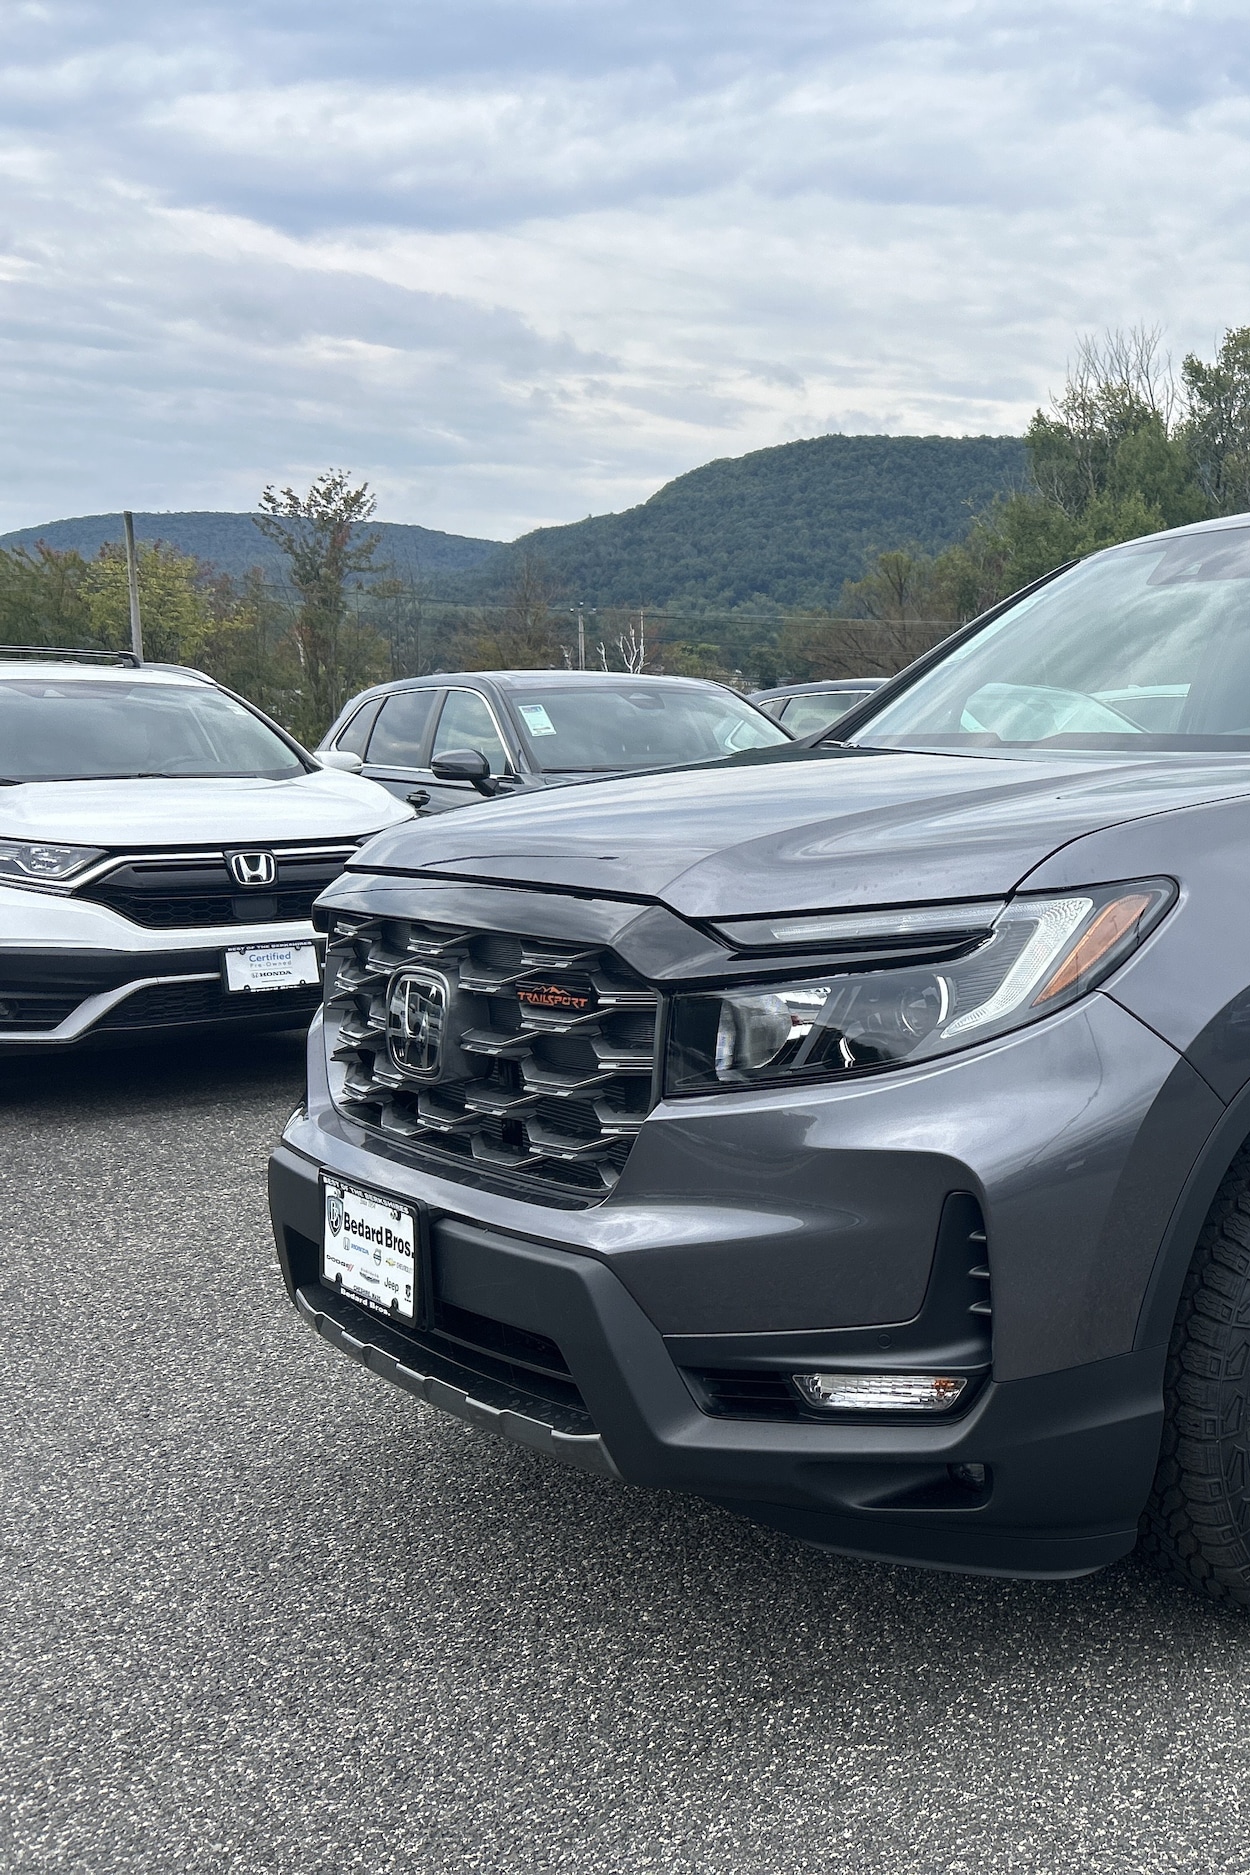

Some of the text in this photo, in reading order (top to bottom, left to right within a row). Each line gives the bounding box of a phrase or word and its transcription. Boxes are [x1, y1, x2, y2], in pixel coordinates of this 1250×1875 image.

[249, 952, 291, 962] Certified
[517, 991, 588, 1009] TRAILSPORT
[323, 1175, 340, 1188] BEST
[348, 1187, 364, 1198] THE
[364, 1192, 409, 1215] BERKSHIRES
[343, 1211, 415, 1259] Bedard Bros.
[350, 1243, 370, 1256] HONDA
[326, 1254, 350, 1268] DODGE
[384, 1276, 400, 1294] Jeep
[340, 1287, 392, 1317] Bedard Bros.
